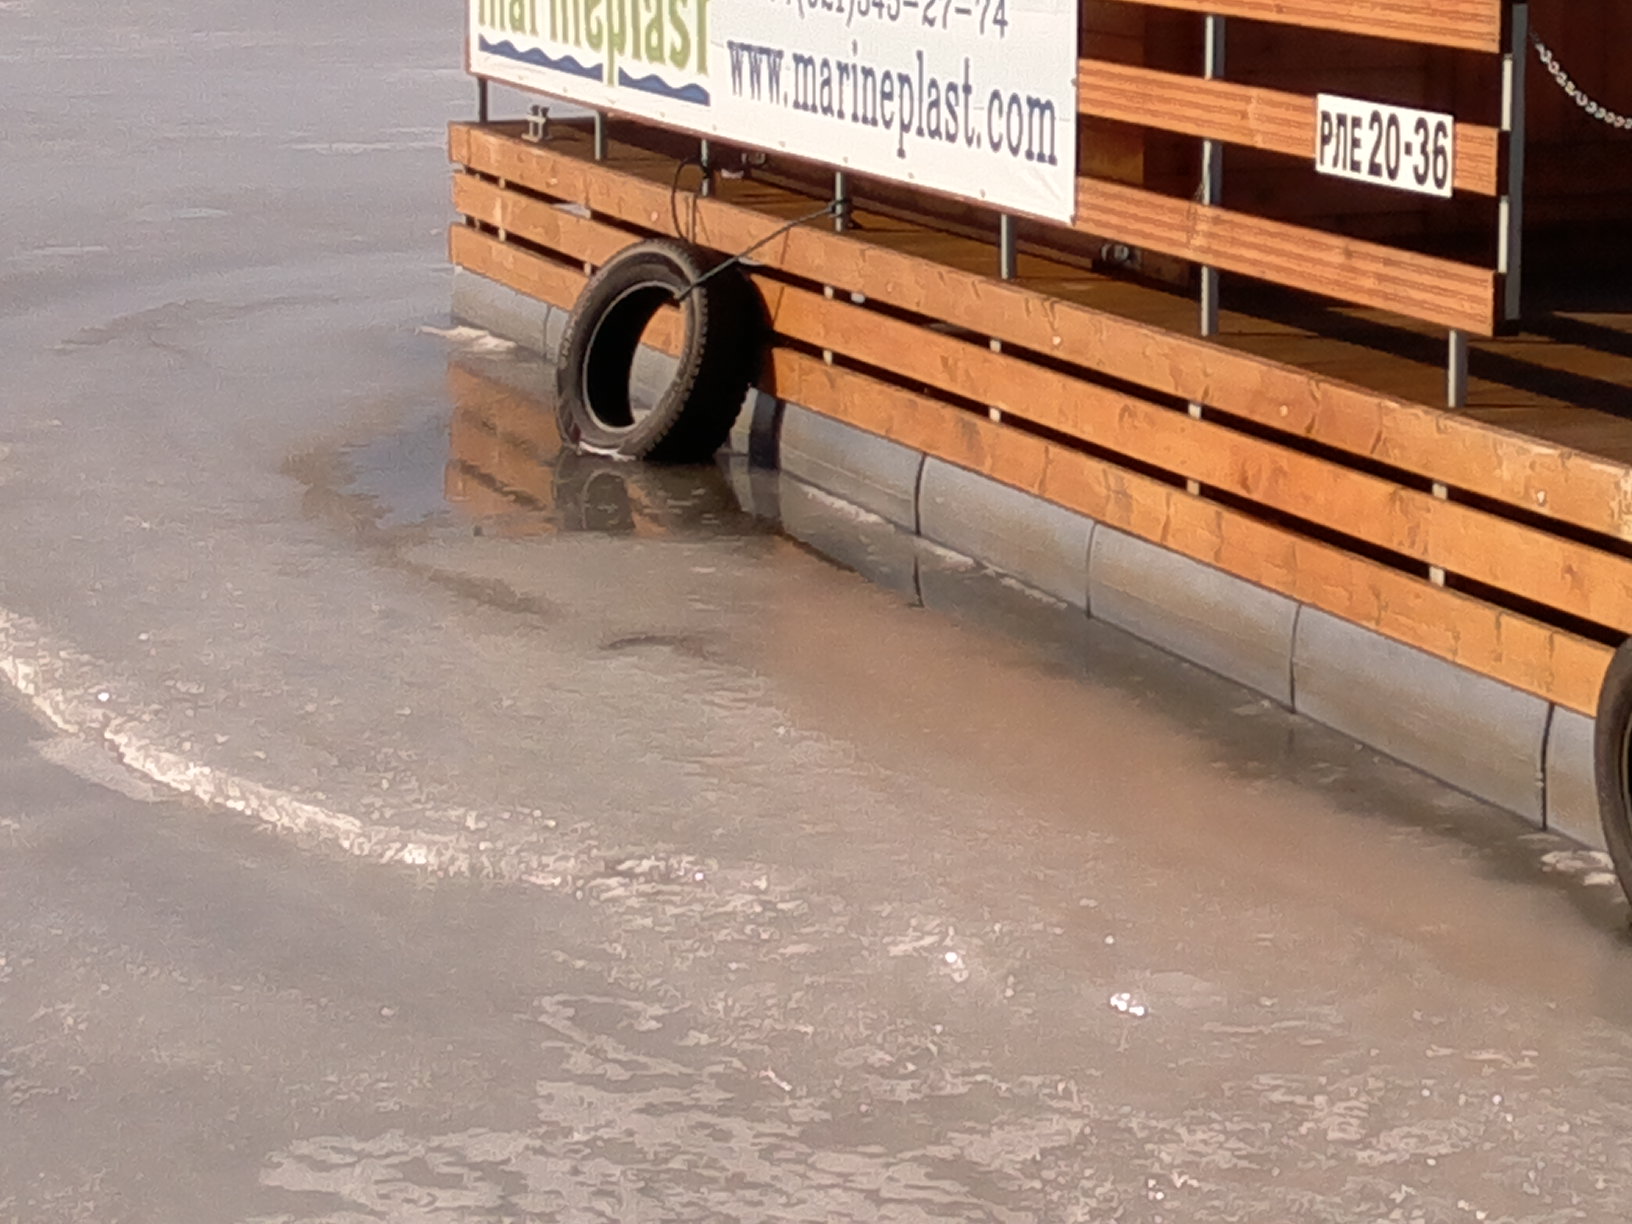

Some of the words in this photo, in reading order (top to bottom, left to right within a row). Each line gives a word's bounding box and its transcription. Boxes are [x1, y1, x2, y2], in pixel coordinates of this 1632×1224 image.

[727, 39, 1057, 165] www.marineplast.com
[1320, 110, 1363, 173] РЛЕ
[1368, 110, 1448, 190] 20-36
